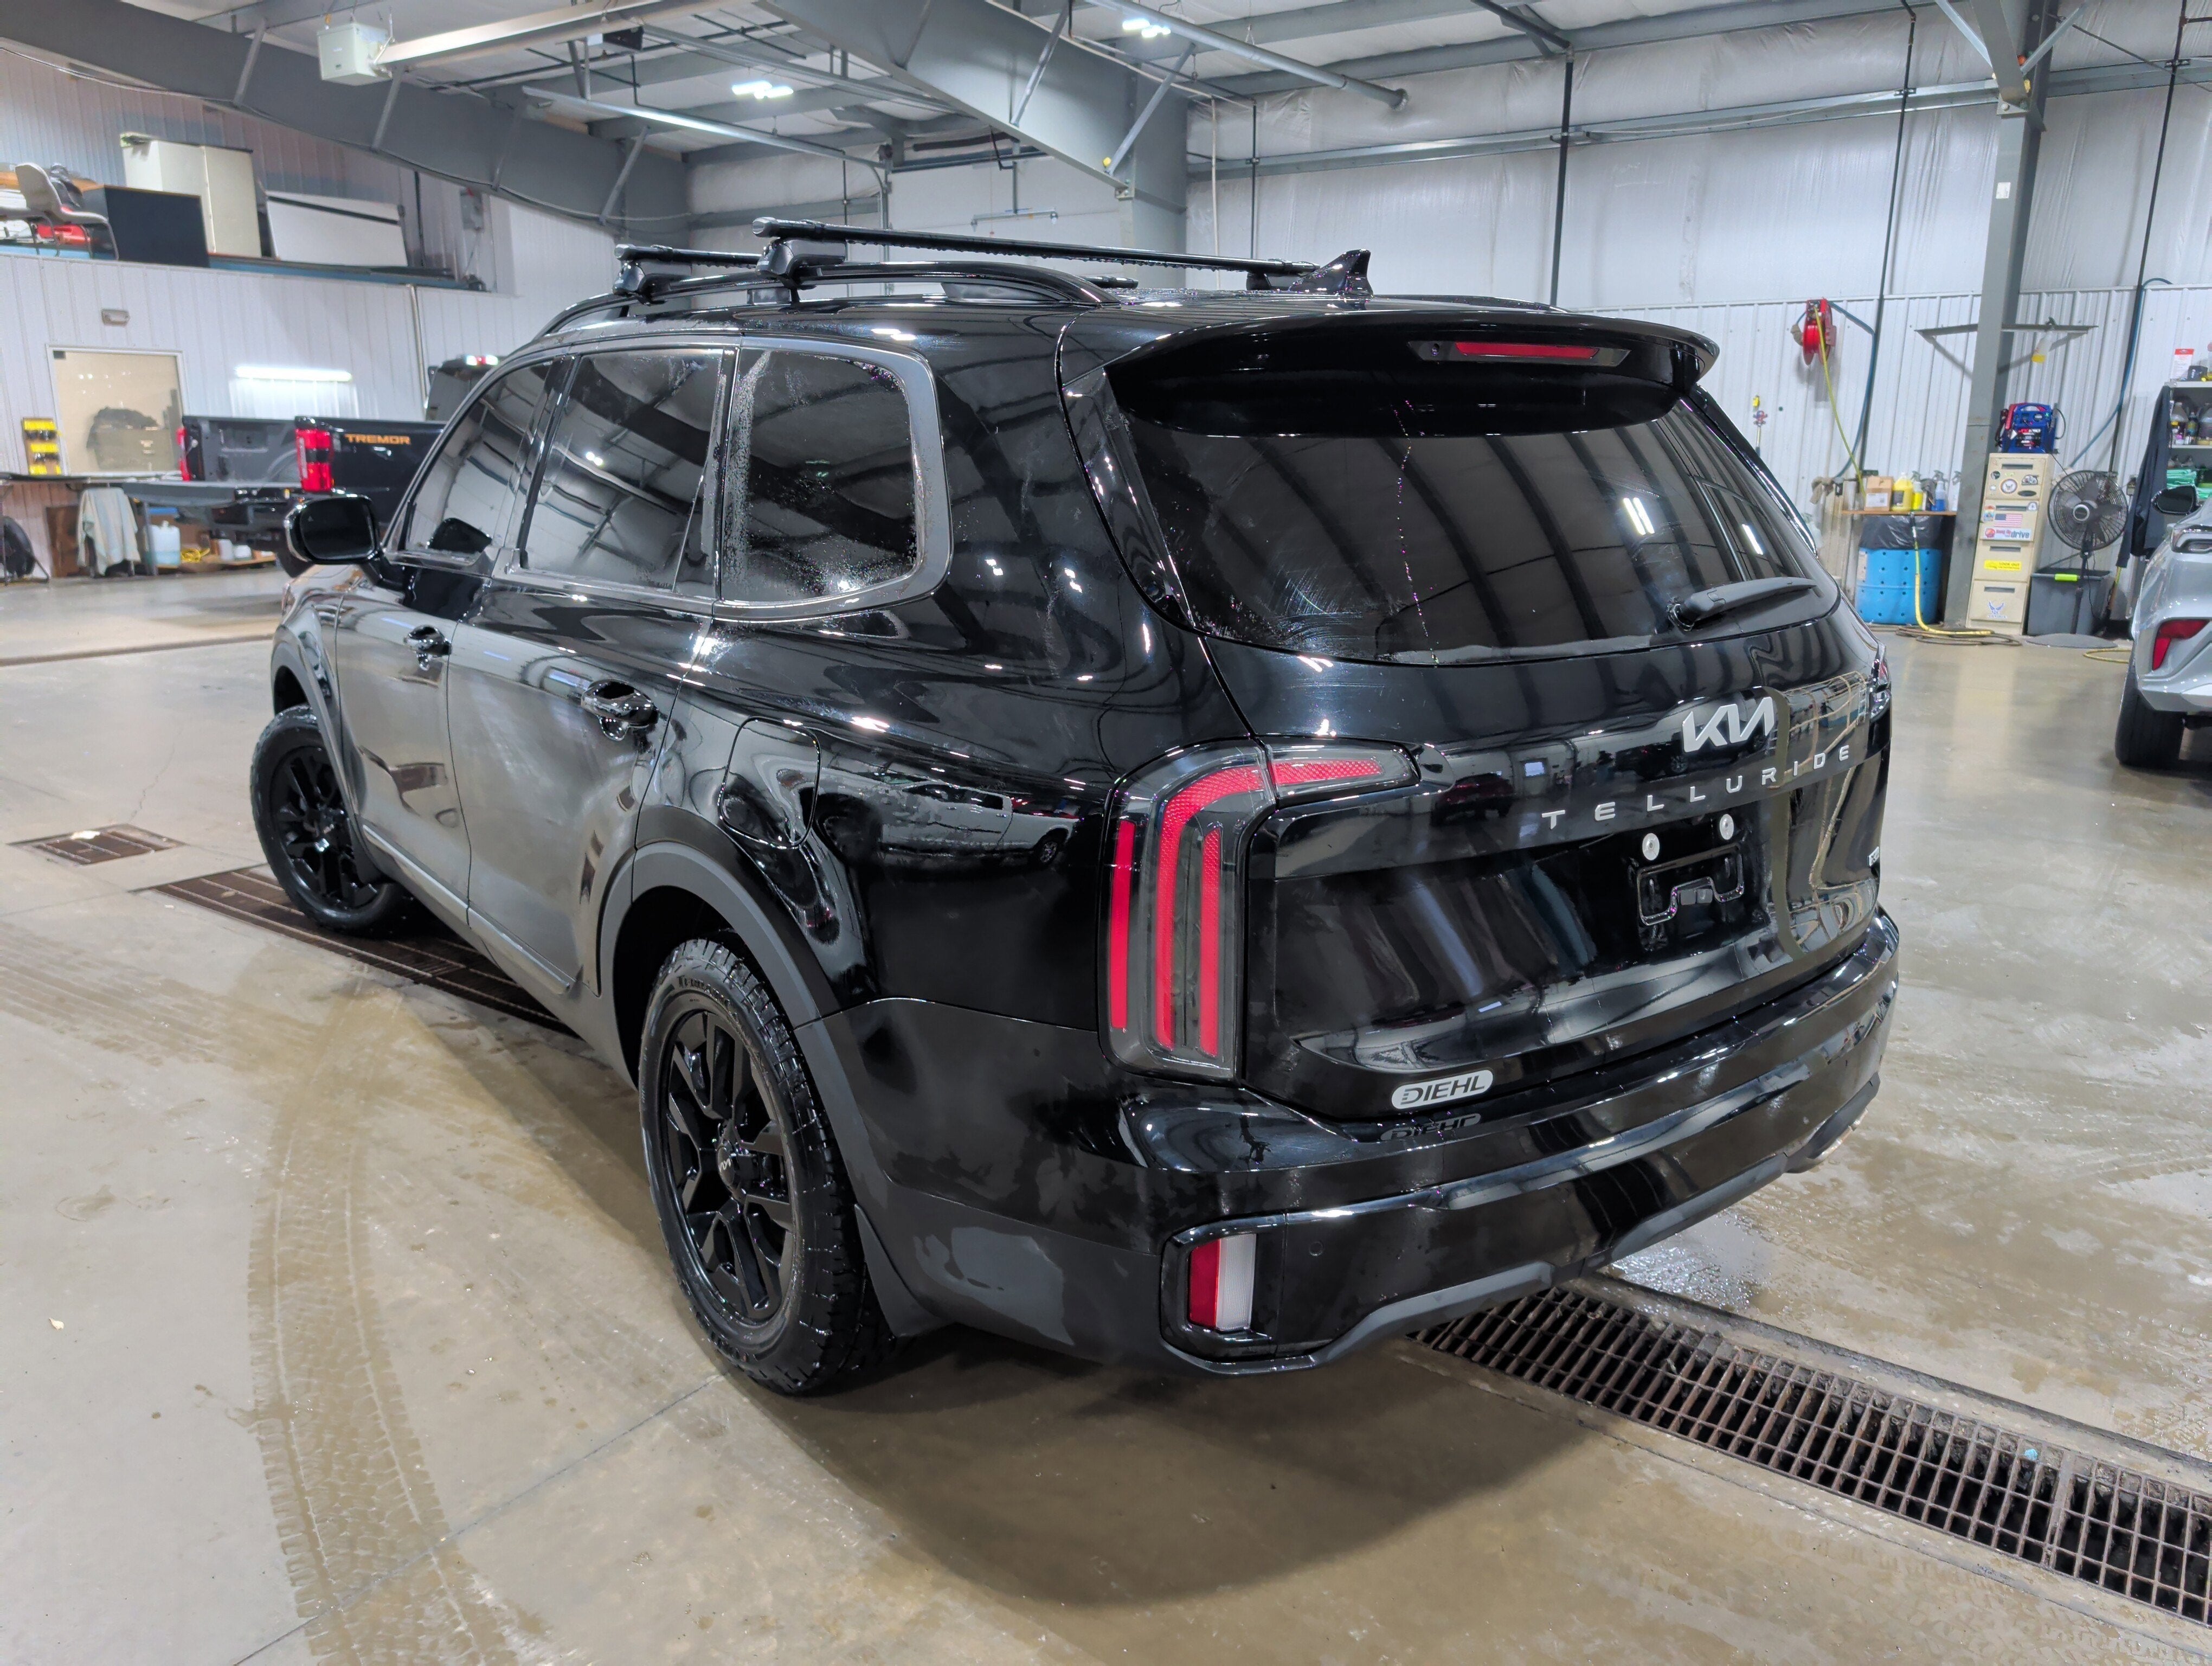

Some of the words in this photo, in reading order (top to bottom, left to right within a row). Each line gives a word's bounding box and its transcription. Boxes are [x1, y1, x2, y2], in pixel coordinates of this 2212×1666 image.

[344, 433, 411, 445] TREMOR
[2011, 530, 2030, 539] drive
[1682, 696, 1774, 753] KIA
[1541, 745, 1850, 829] TELLURIDE
[1400, 1075, 1485, 1105] DIEHL
